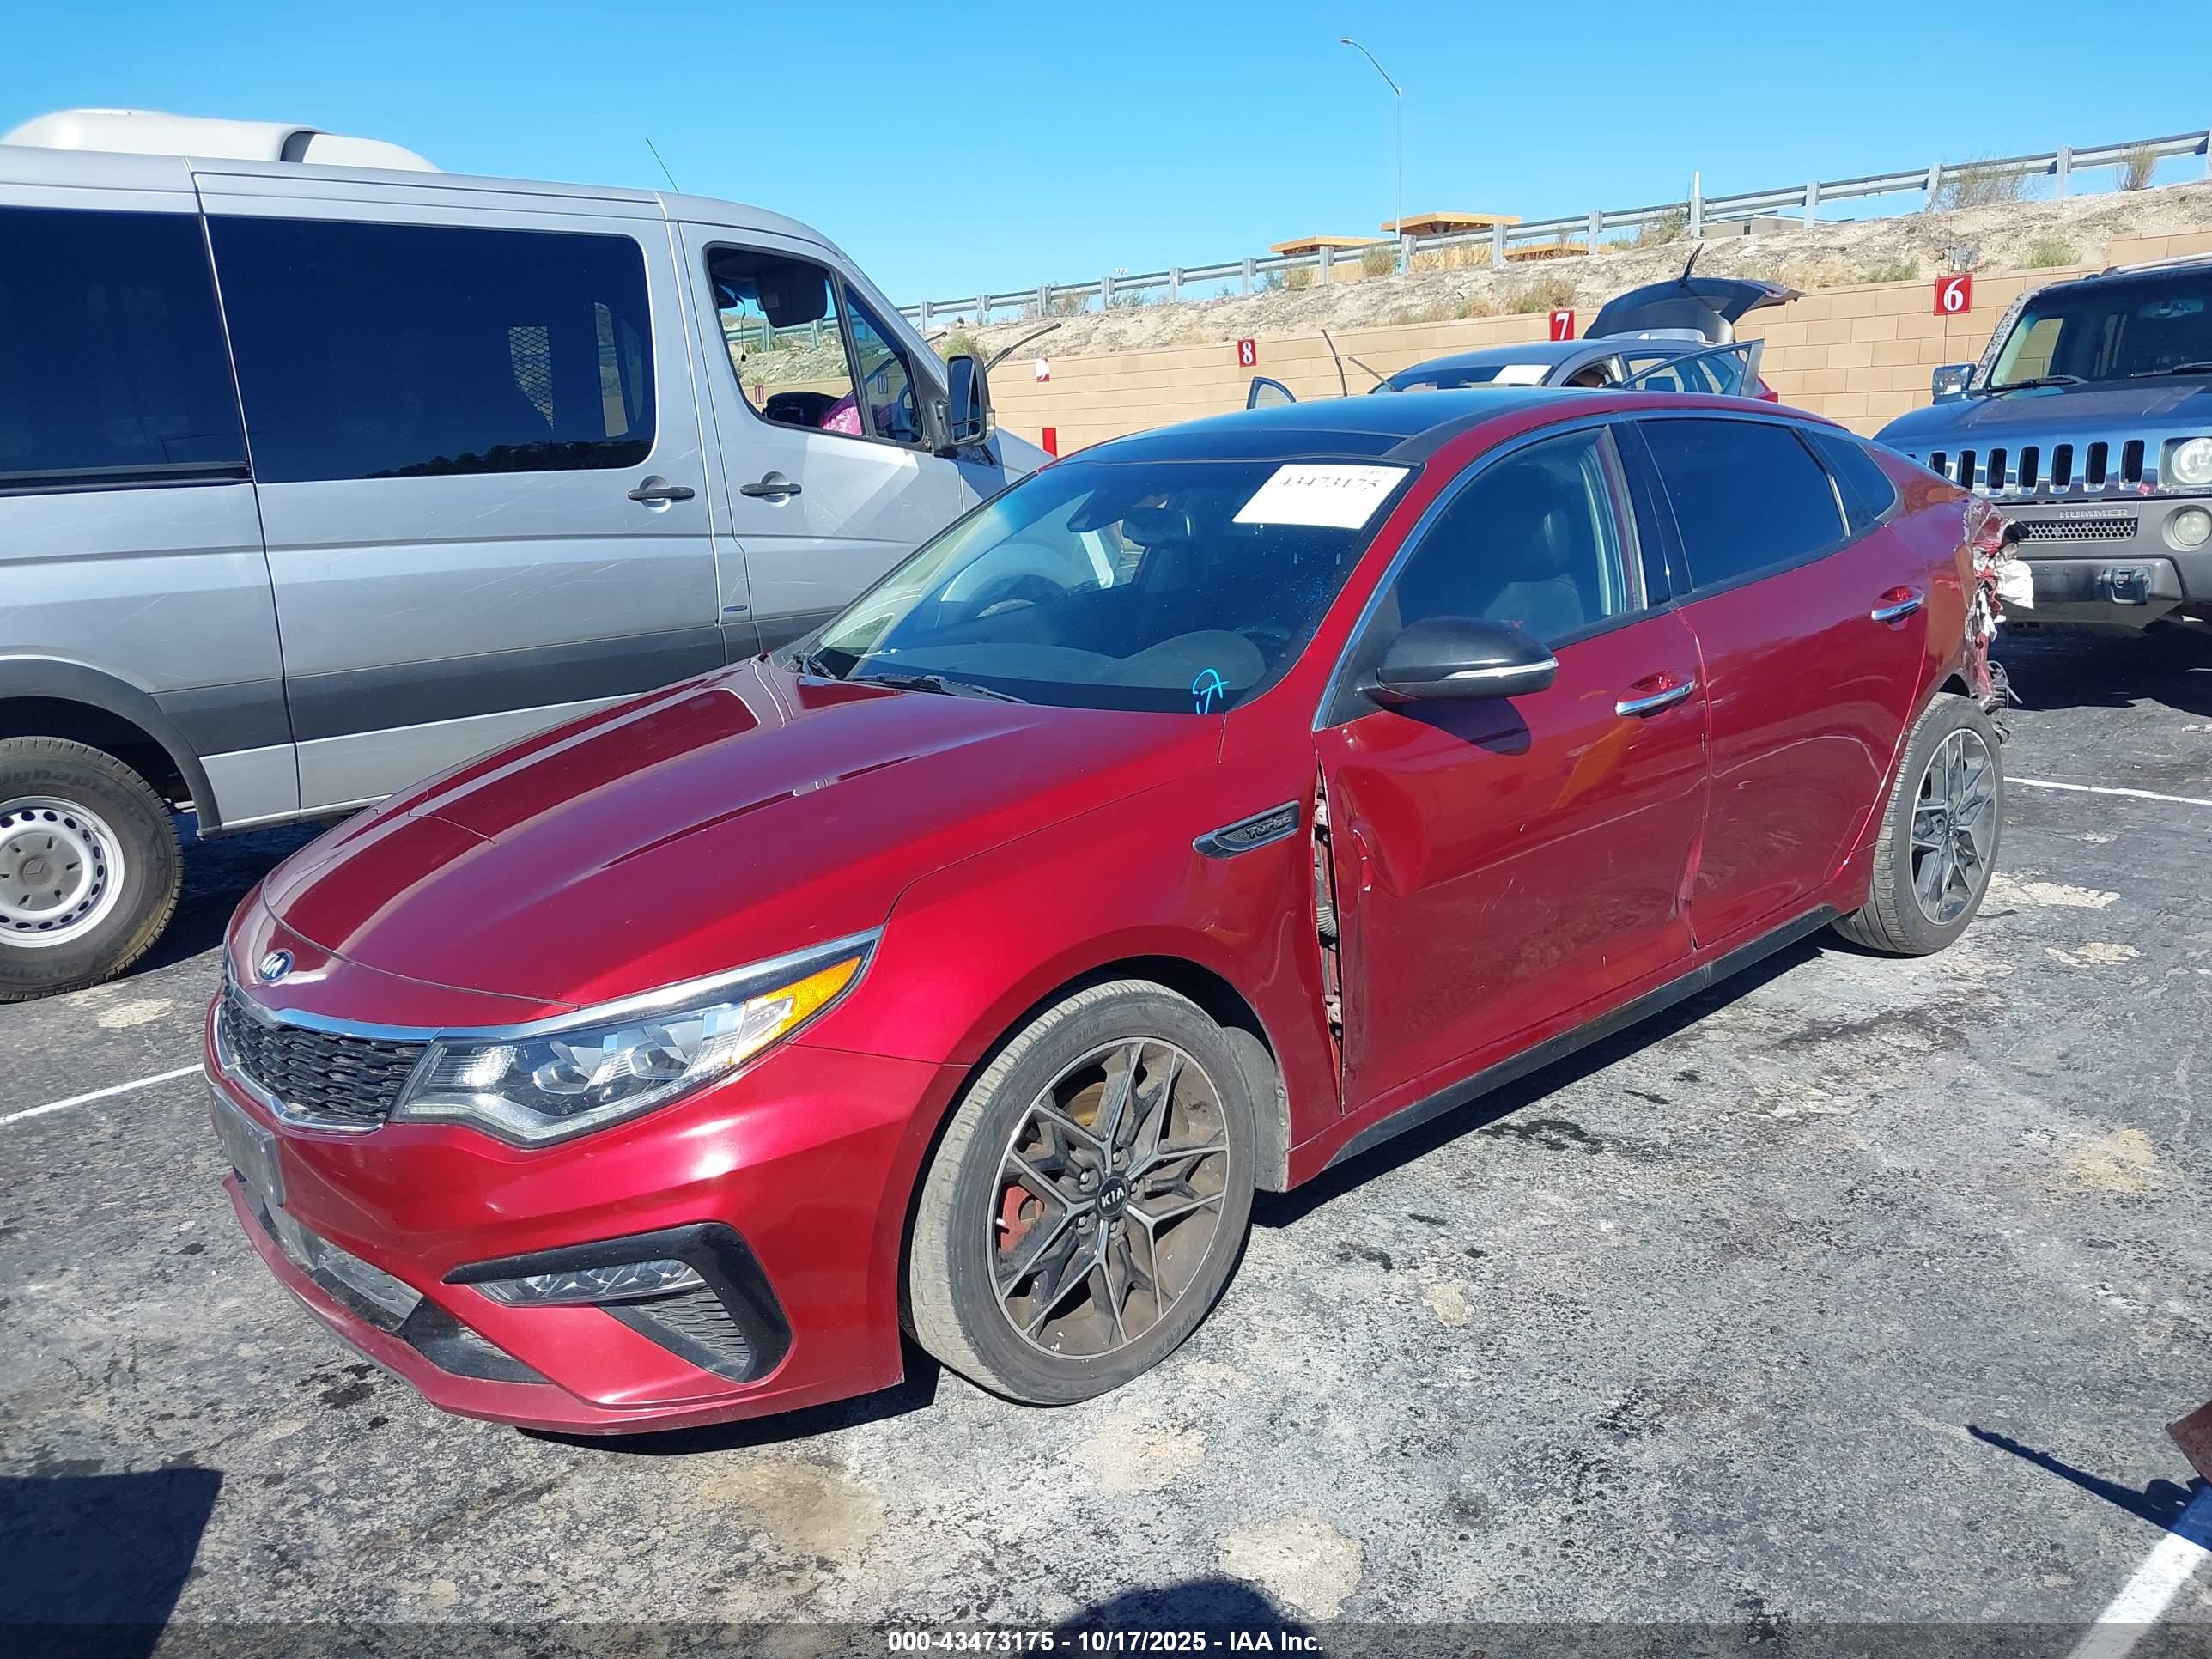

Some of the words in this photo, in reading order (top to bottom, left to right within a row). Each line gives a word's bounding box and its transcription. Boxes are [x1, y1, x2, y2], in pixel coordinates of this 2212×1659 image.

[1943, 277, 1964, 311] 6
[1555, 313, 1570, 340] 7
[1242, 341, 1254, 364] 8
[2059, 509, 2129, 519] HUMMER
[260, 952, 285, 977] KIA
[1101, 1187, 1125, 1207] KIA
